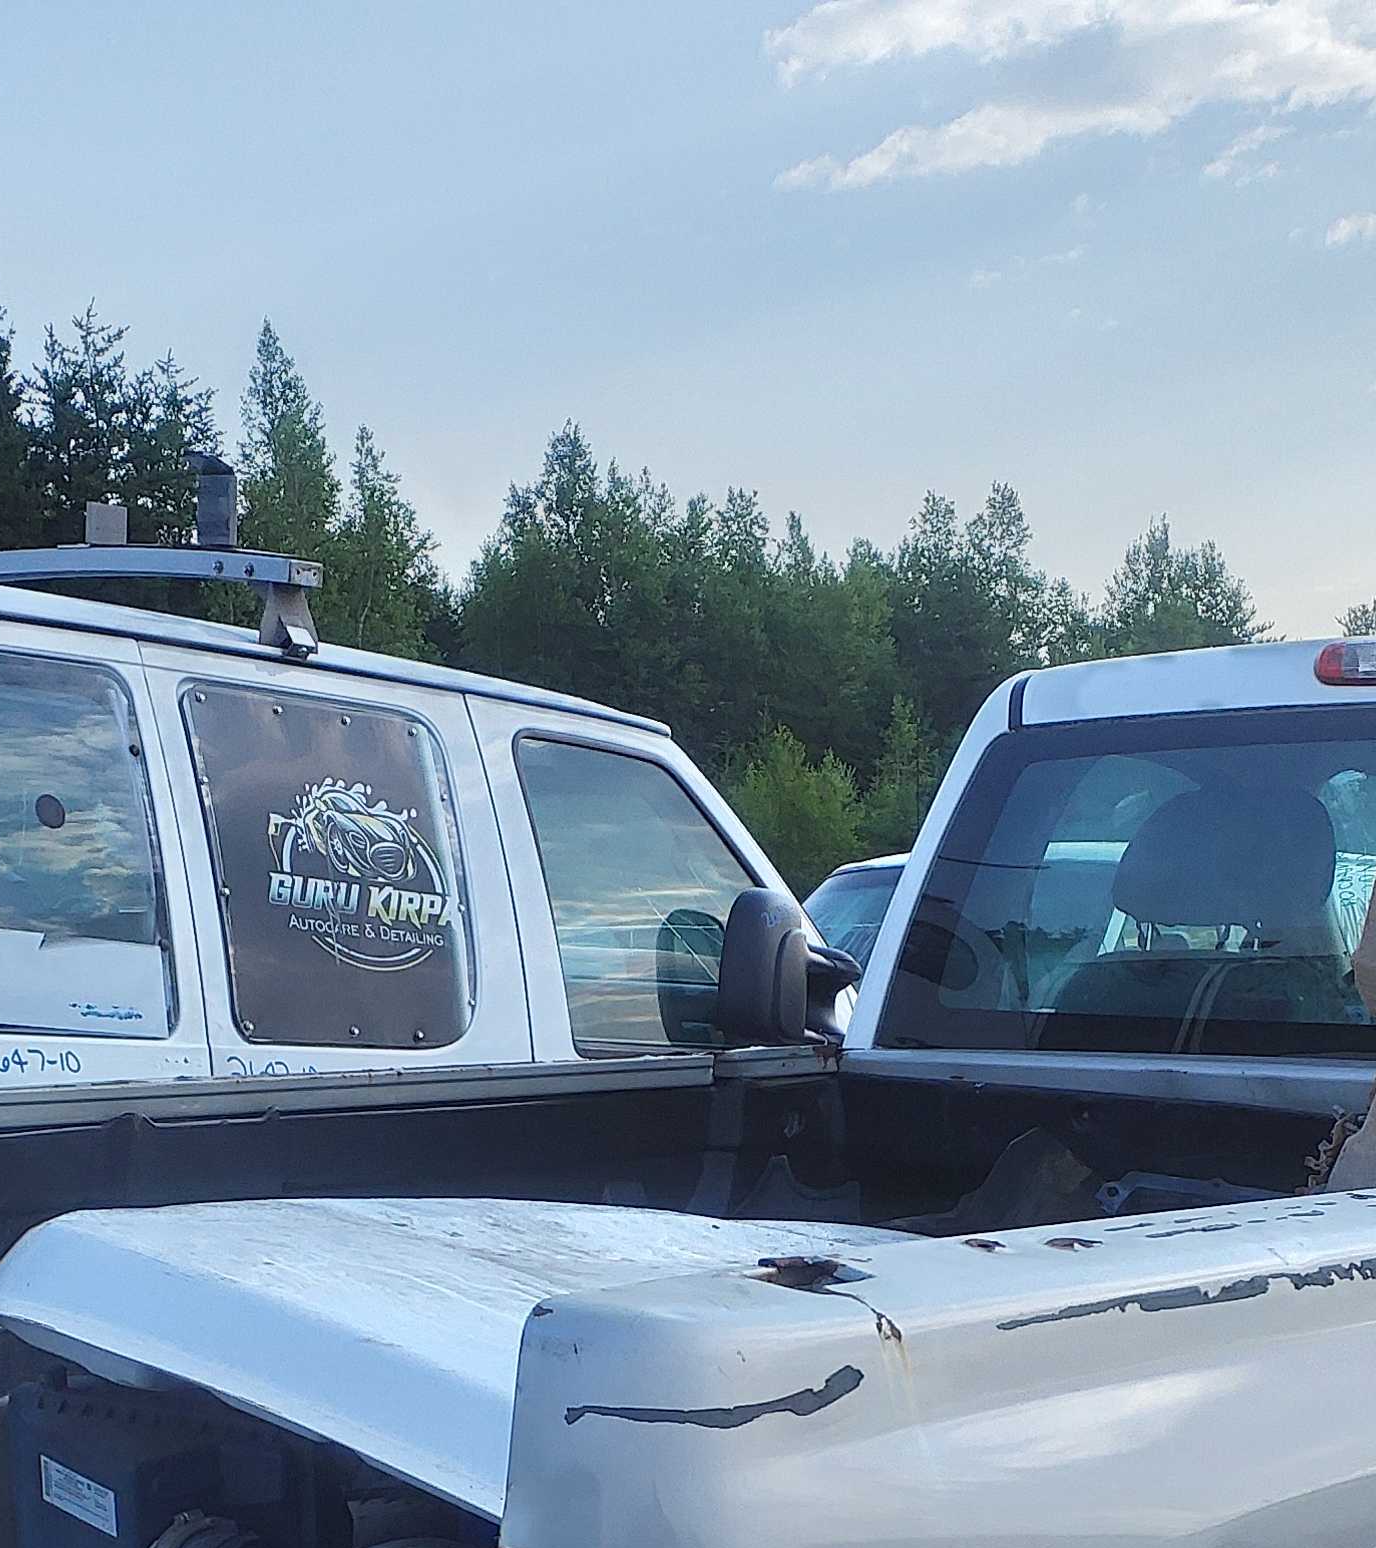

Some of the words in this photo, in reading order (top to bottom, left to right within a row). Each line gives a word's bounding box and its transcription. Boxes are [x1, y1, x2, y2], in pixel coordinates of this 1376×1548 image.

[268, 872, 360, 914] GURU
[368, 885, 460, 930] KIRPA
[364, 924, 375, 938] &
